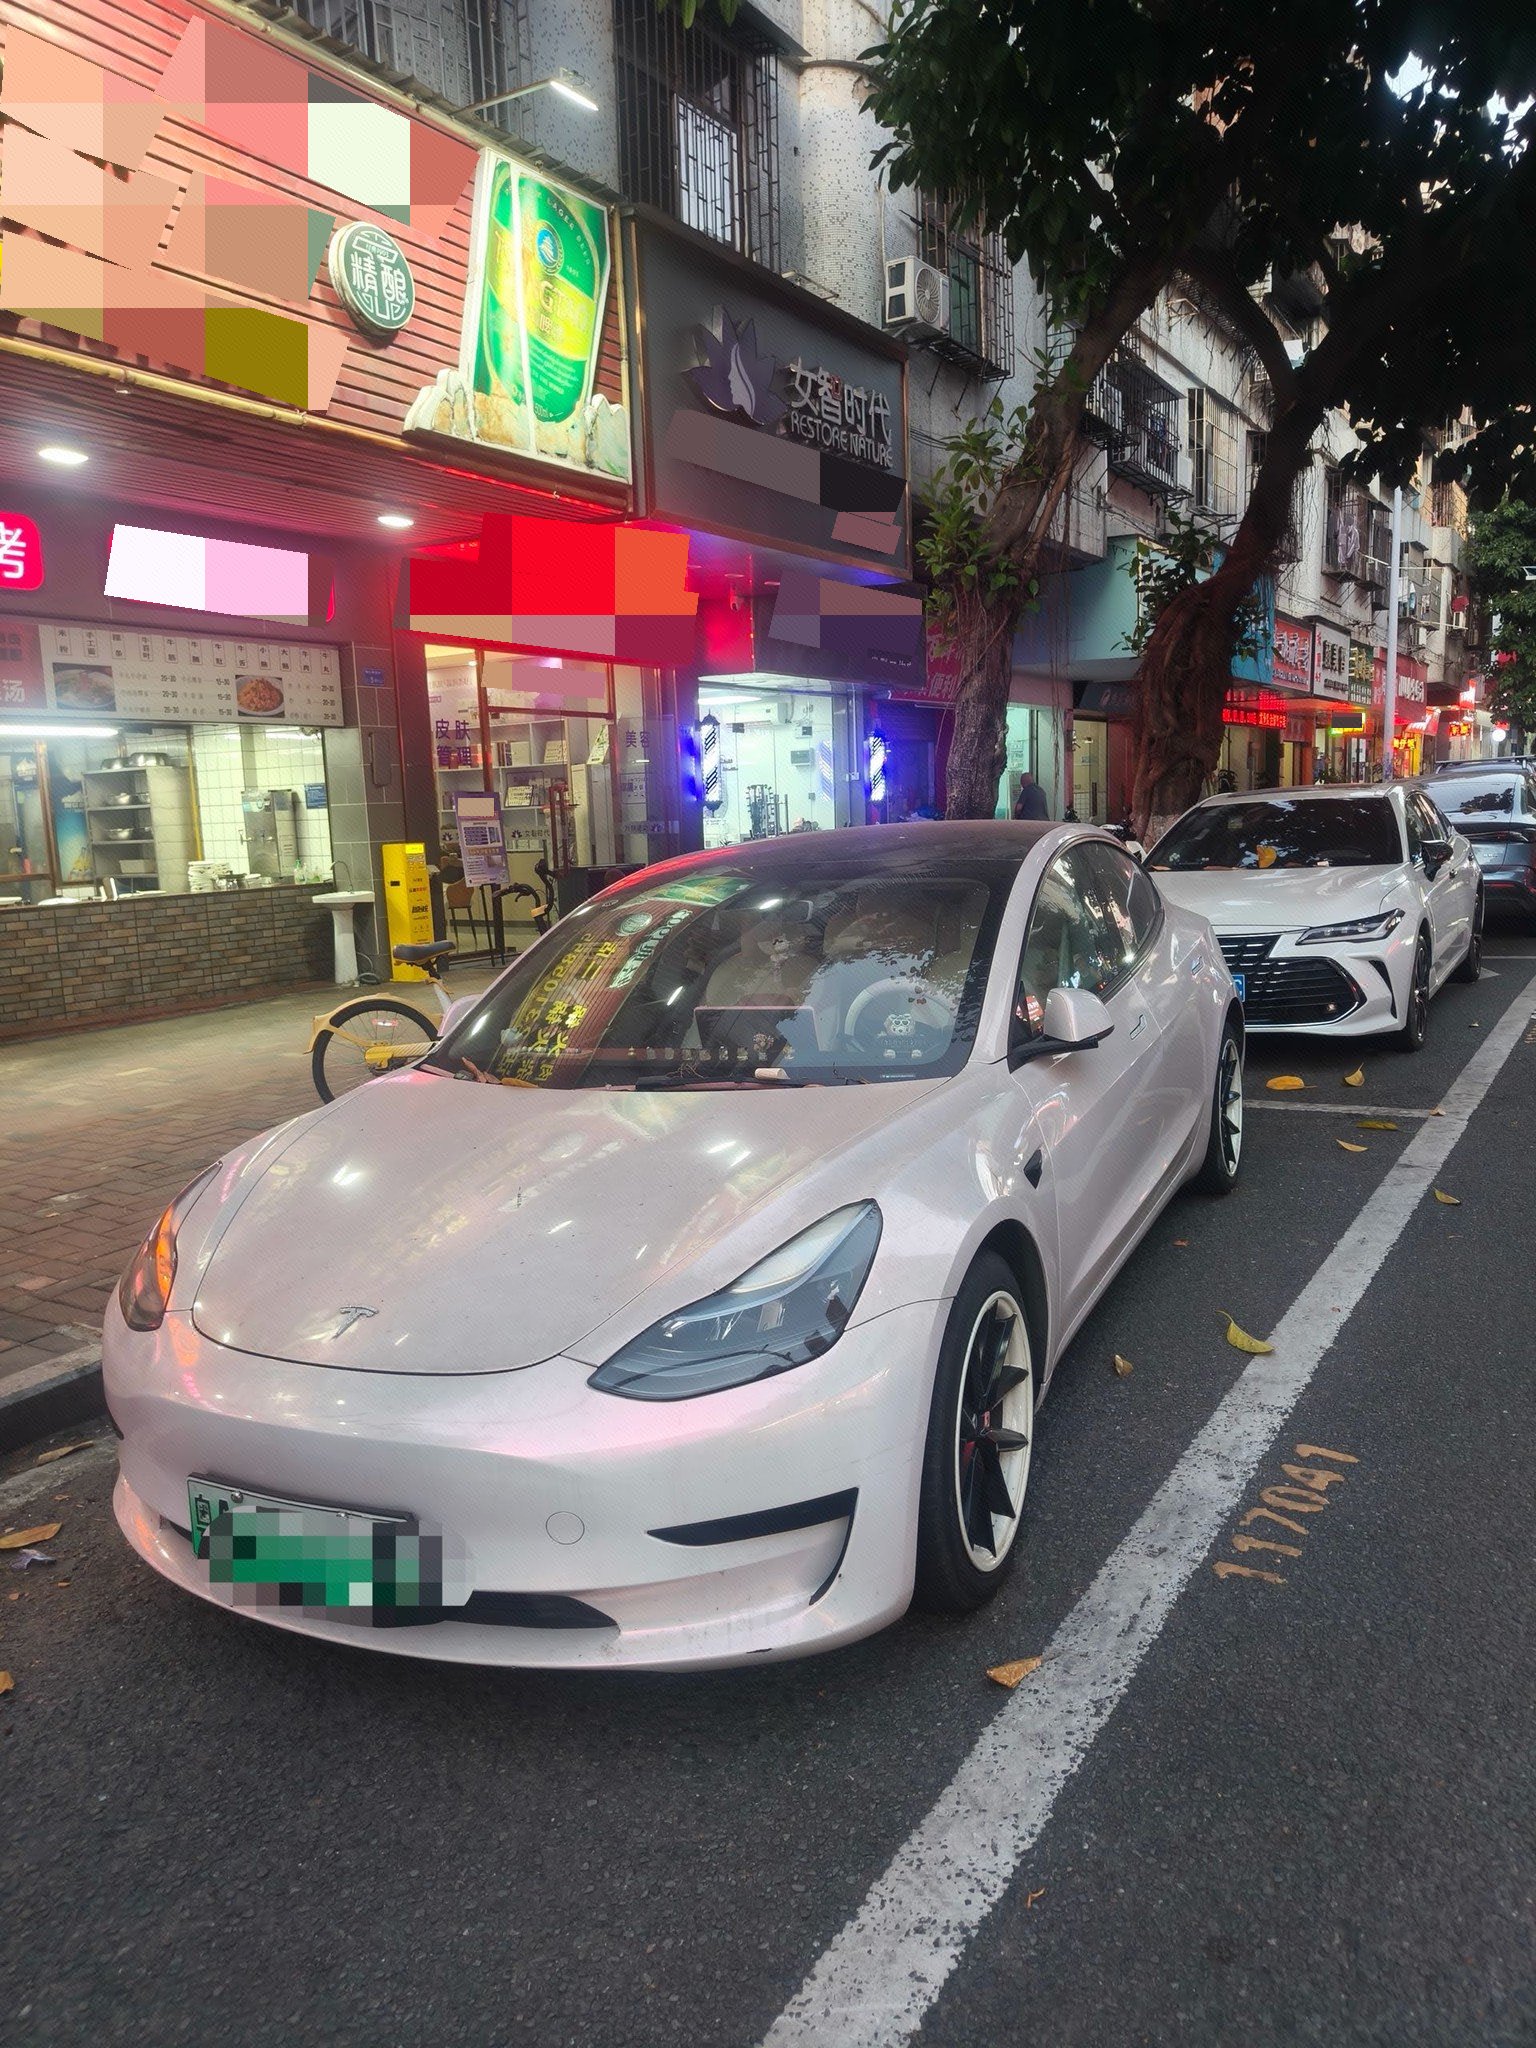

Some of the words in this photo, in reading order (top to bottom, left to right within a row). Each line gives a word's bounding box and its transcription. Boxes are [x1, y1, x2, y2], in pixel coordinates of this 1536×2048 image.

[351, 251, 409, 305] 精酿
[789, 356, 891, 446] 女智时代
[790, 410, 848, 451] RESTORE
[849, 432, 893, 468] NATURE
[435, 719, 471, 741] 皮肤
[625, 730, 650, 748] 美容
[436, 746, 472, 766] 管理
